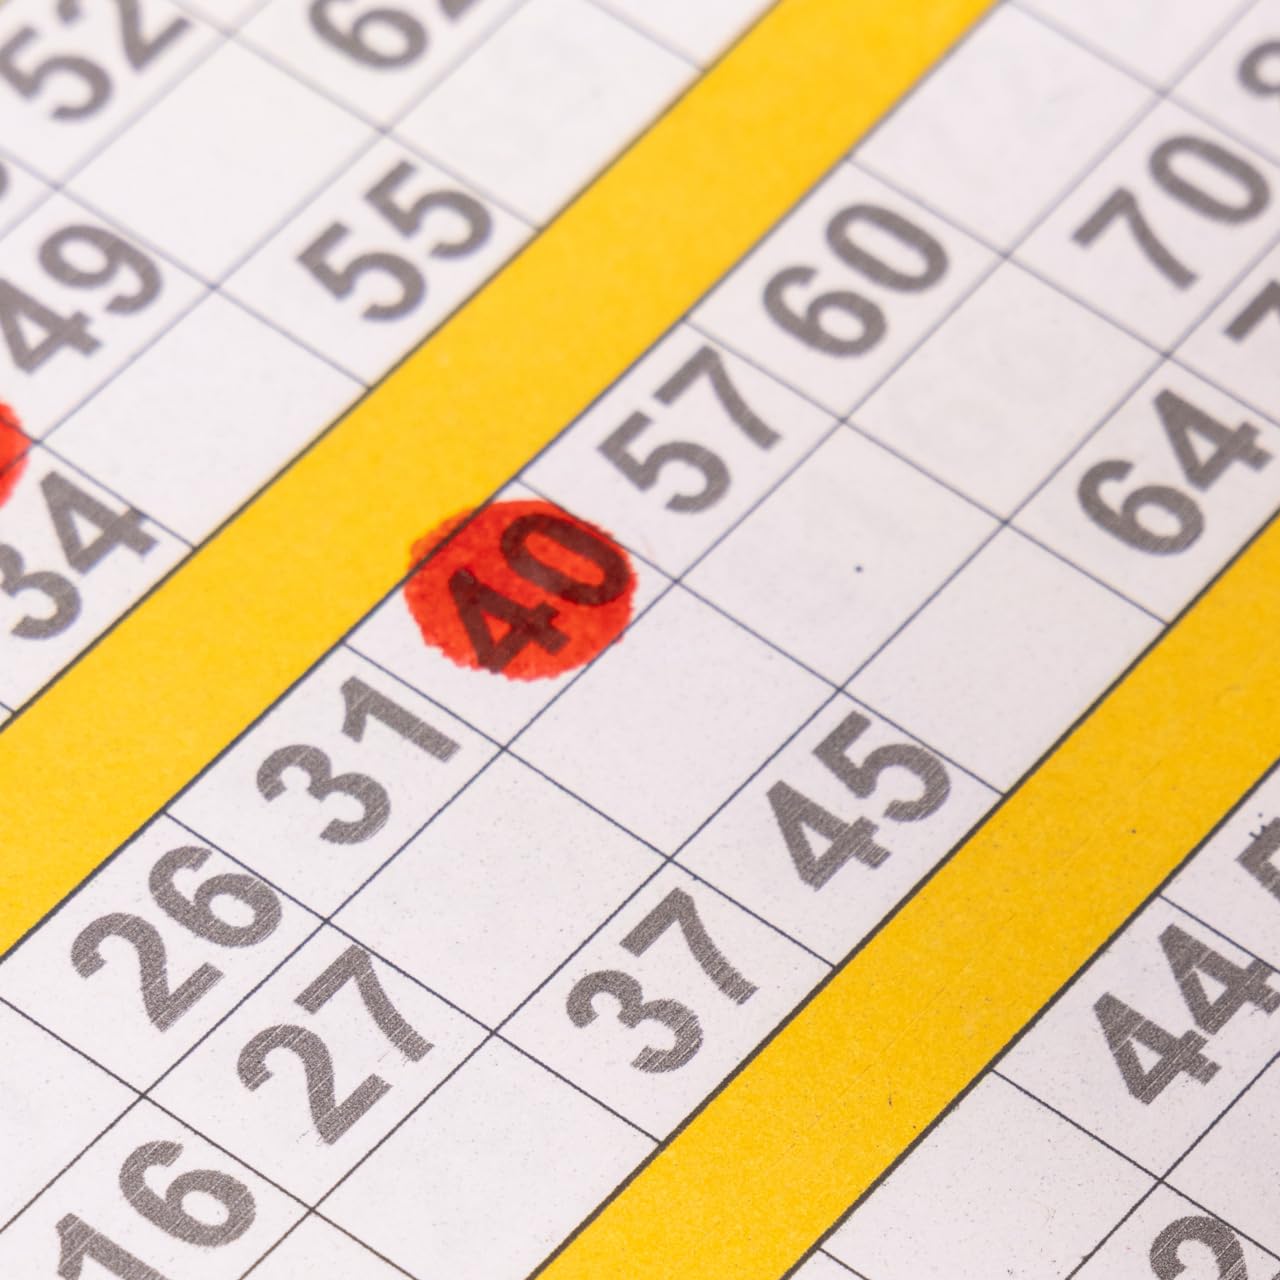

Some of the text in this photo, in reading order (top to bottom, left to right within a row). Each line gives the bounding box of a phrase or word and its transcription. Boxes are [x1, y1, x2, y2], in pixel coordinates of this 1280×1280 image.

[309, 0, 482, 70] 6
[296, 162, 494, 322] 55
[763, 204, 949, 358] 60
[1071, 135, 1272, 291] 70
[0, 224, 164, 373] 49
[597, 346, 781, 514] 57
[1076, 388, 1275, 556] 64
[448, 513, 631, 673] 40
[256, 676, 460, 845] 31
[766, 711, 951, 890] 45
[70, 845, 283, 1032] 26
[566, 888, 758, 1074] 37
[236, 945, 434, 1144] 27
